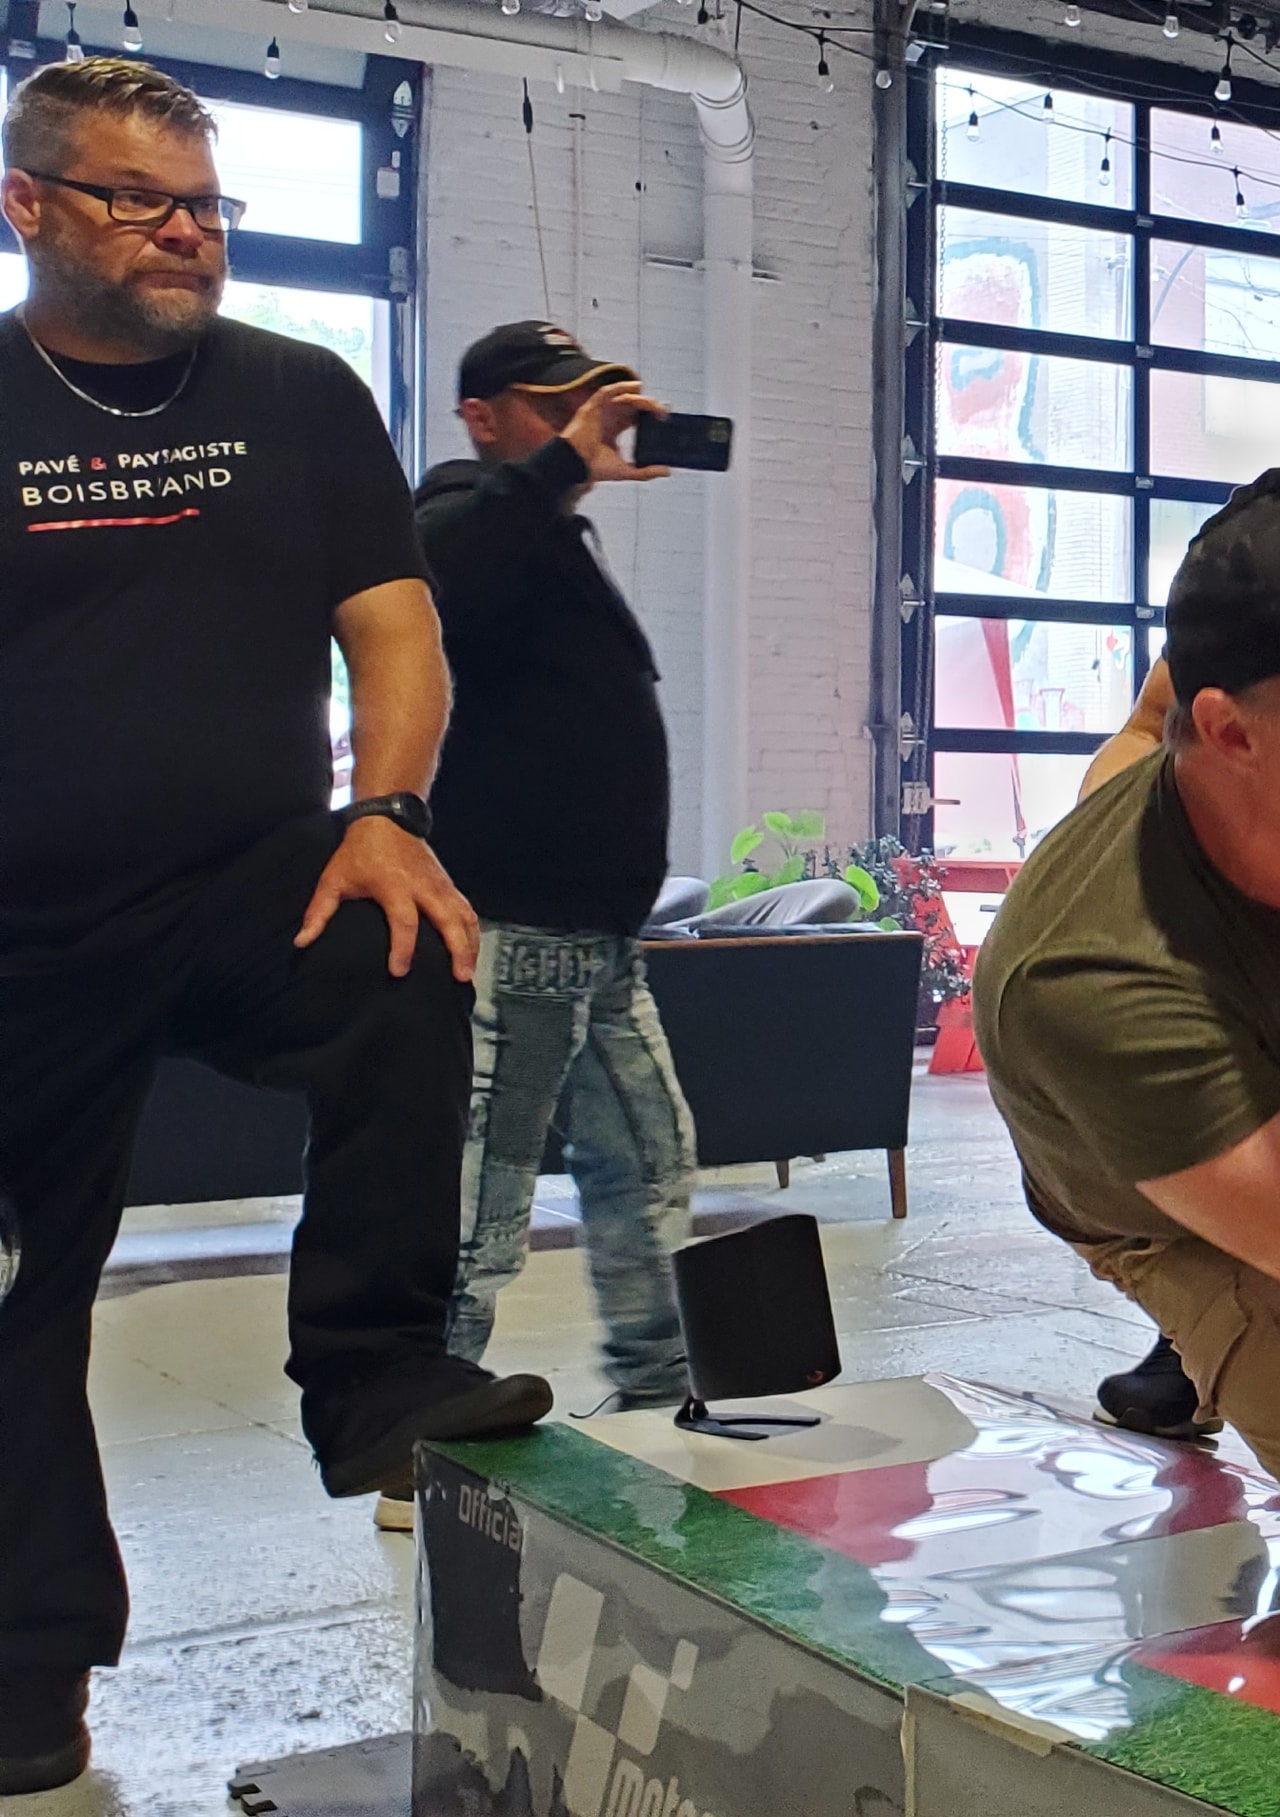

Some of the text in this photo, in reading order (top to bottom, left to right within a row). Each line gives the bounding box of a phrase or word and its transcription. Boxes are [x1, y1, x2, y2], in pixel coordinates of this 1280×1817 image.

[18, 440, 248, 476] PAVÉ & PAYSAGISTE
[22, 467, 233, 507] BOISBRAND
